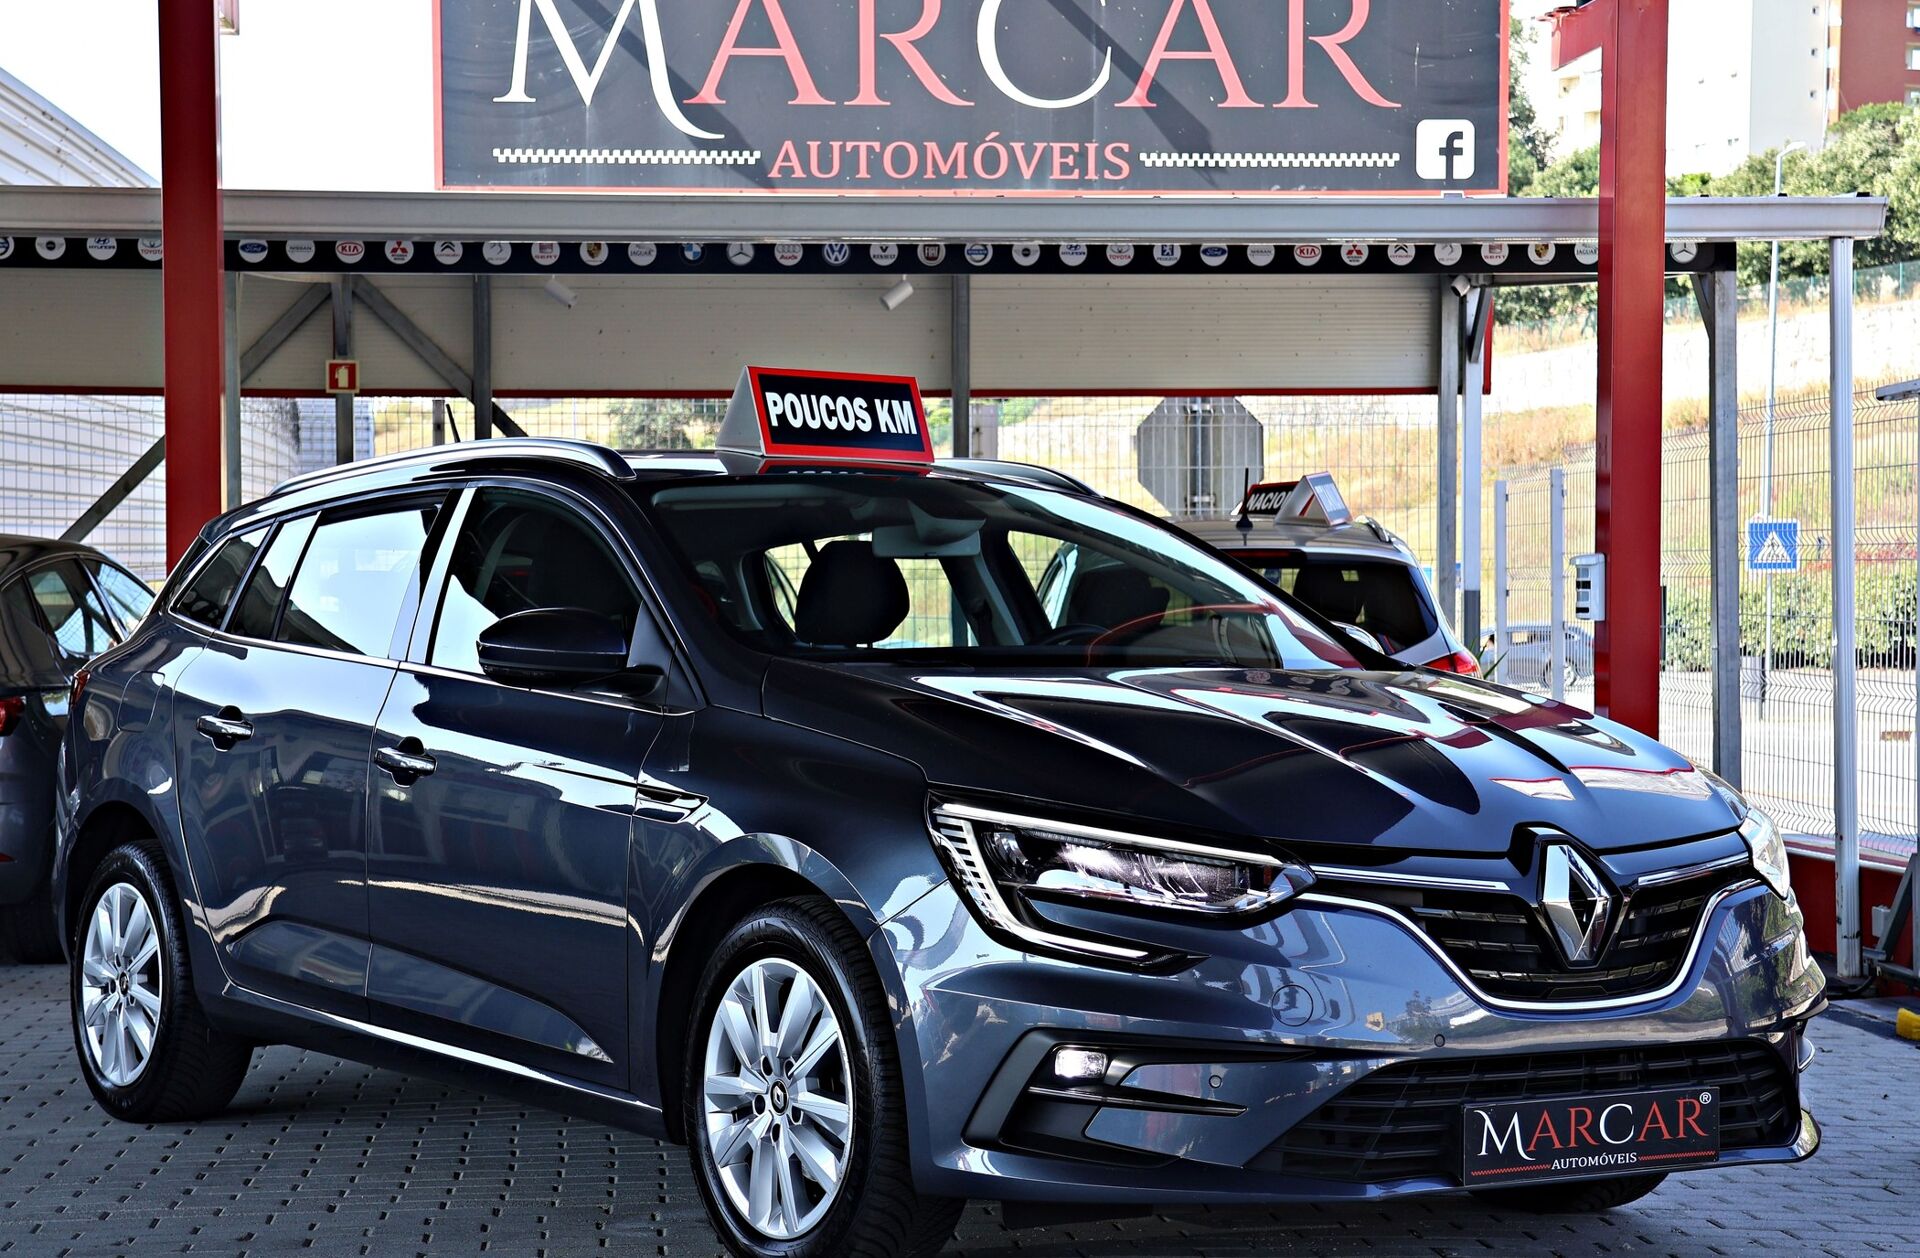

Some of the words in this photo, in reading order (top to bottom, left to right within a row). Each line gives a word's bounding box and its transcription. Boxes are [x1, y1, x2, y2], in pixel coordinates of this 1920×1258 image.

[492, 0, 1401, 139] MARCAR
[768, 131, 1130, 180] AUTOMÓVEIS
[765, 392, 872, 432] POUCOS
[874, 399, 918, 435] KM
[1551, 1152, 1638, 1170] AUTOMÓVEIS
